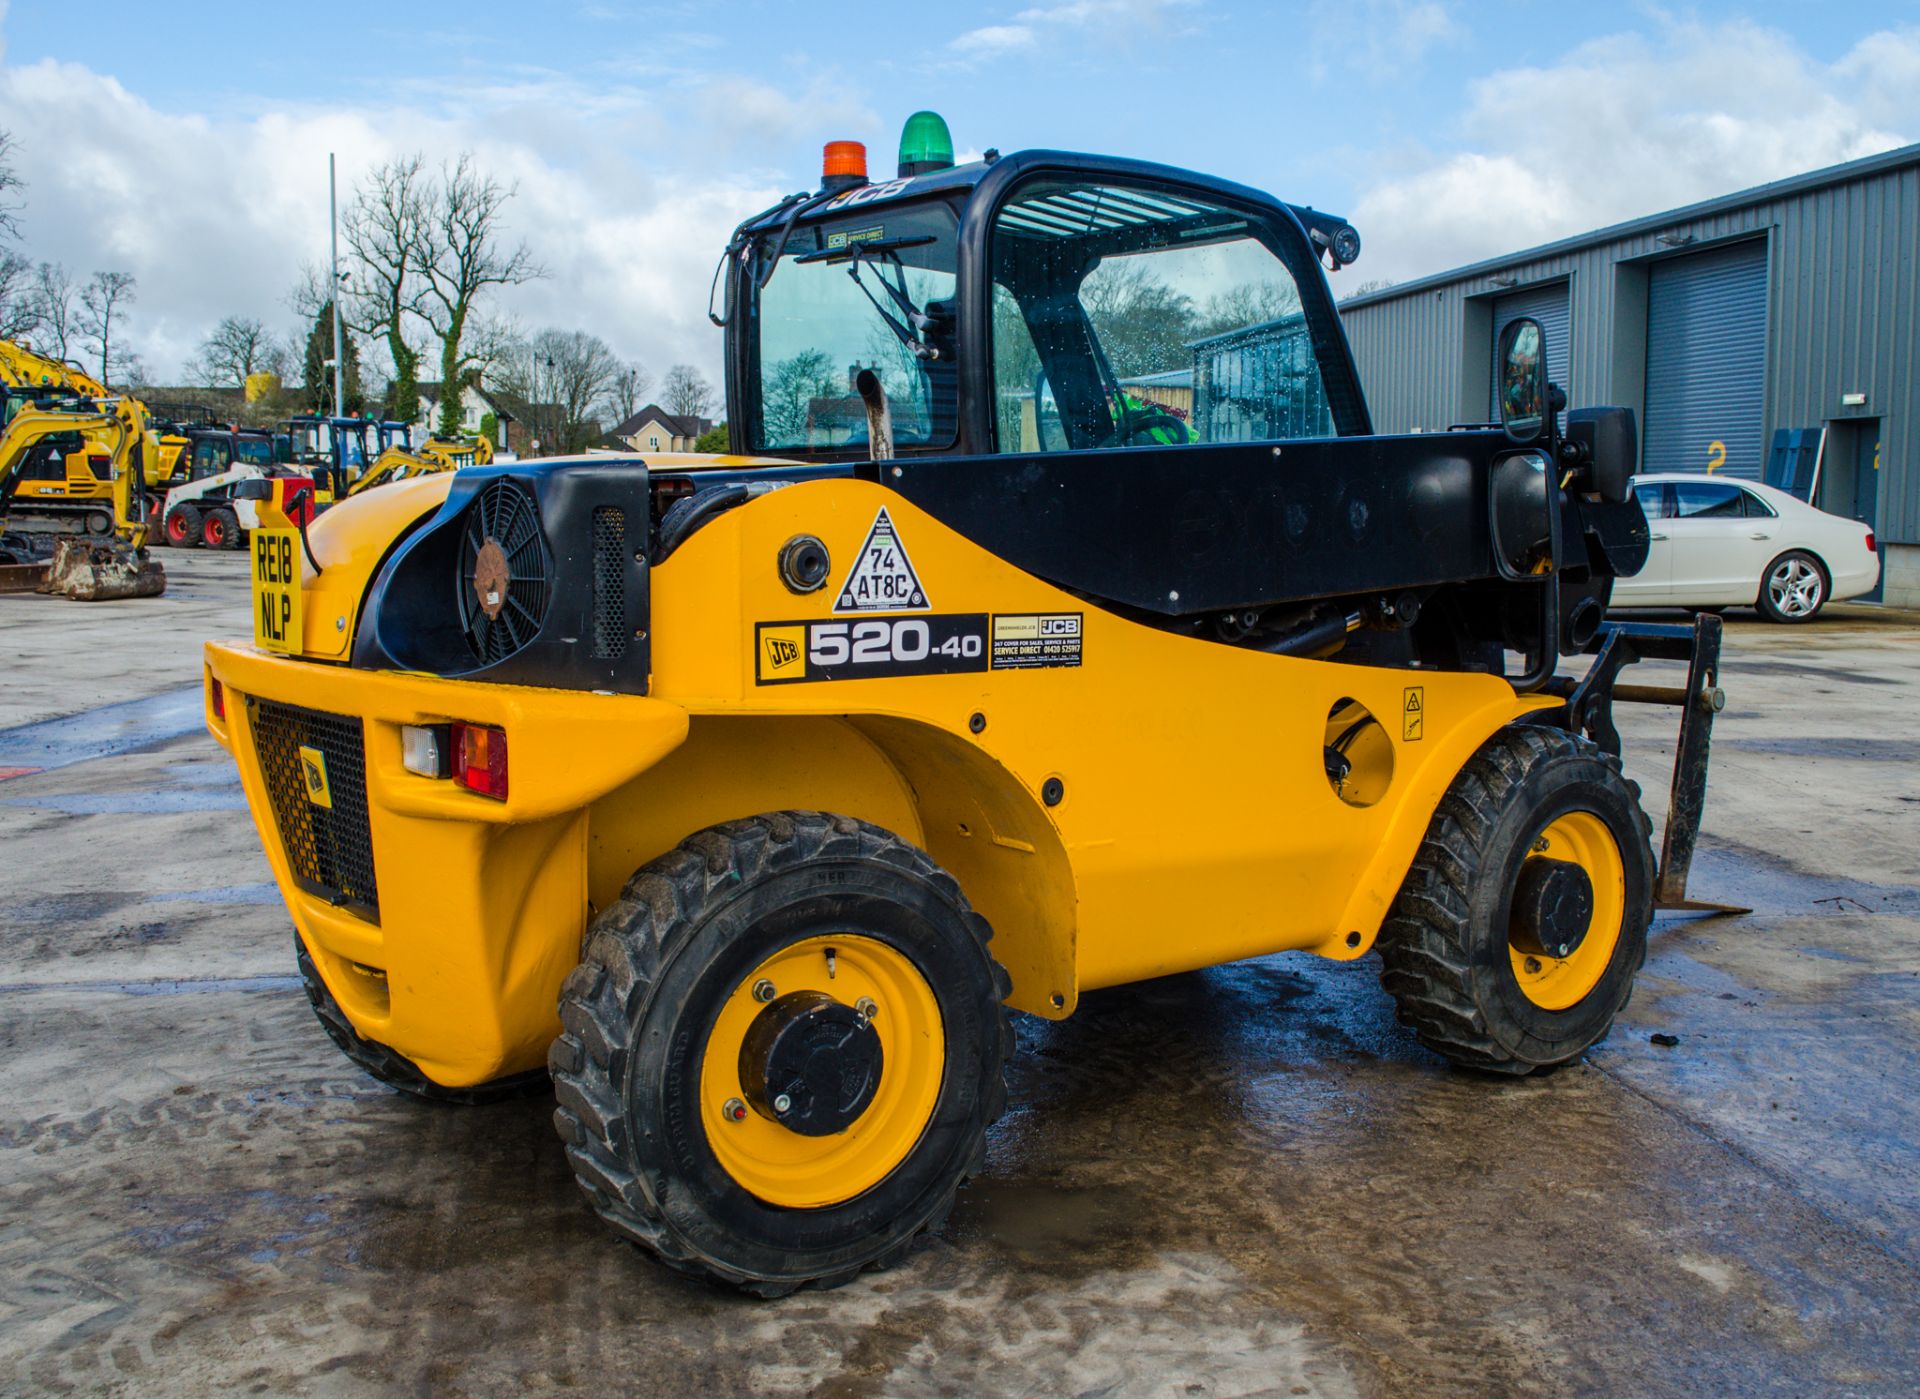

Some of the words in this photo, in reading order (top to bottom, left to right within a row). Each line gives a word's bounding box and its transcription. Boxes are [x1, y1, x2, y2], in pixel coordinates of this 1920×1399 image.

[826, 177, 916, 210] JCB
[1707, 440, 1727, 477] 2
[257, 534, 292, 584] RE18
[871, 548, 895, 572] 74
[857, 574, 908, 599] AT8C
[261, 591, 291, 642] NLP
[1042, 620, 1077, 634] JCB
[771, 641, 798, 666] JCB
[994, 646, 1019, 655] SERVICE
[1019, 646, 1041, 655] DIRECT
